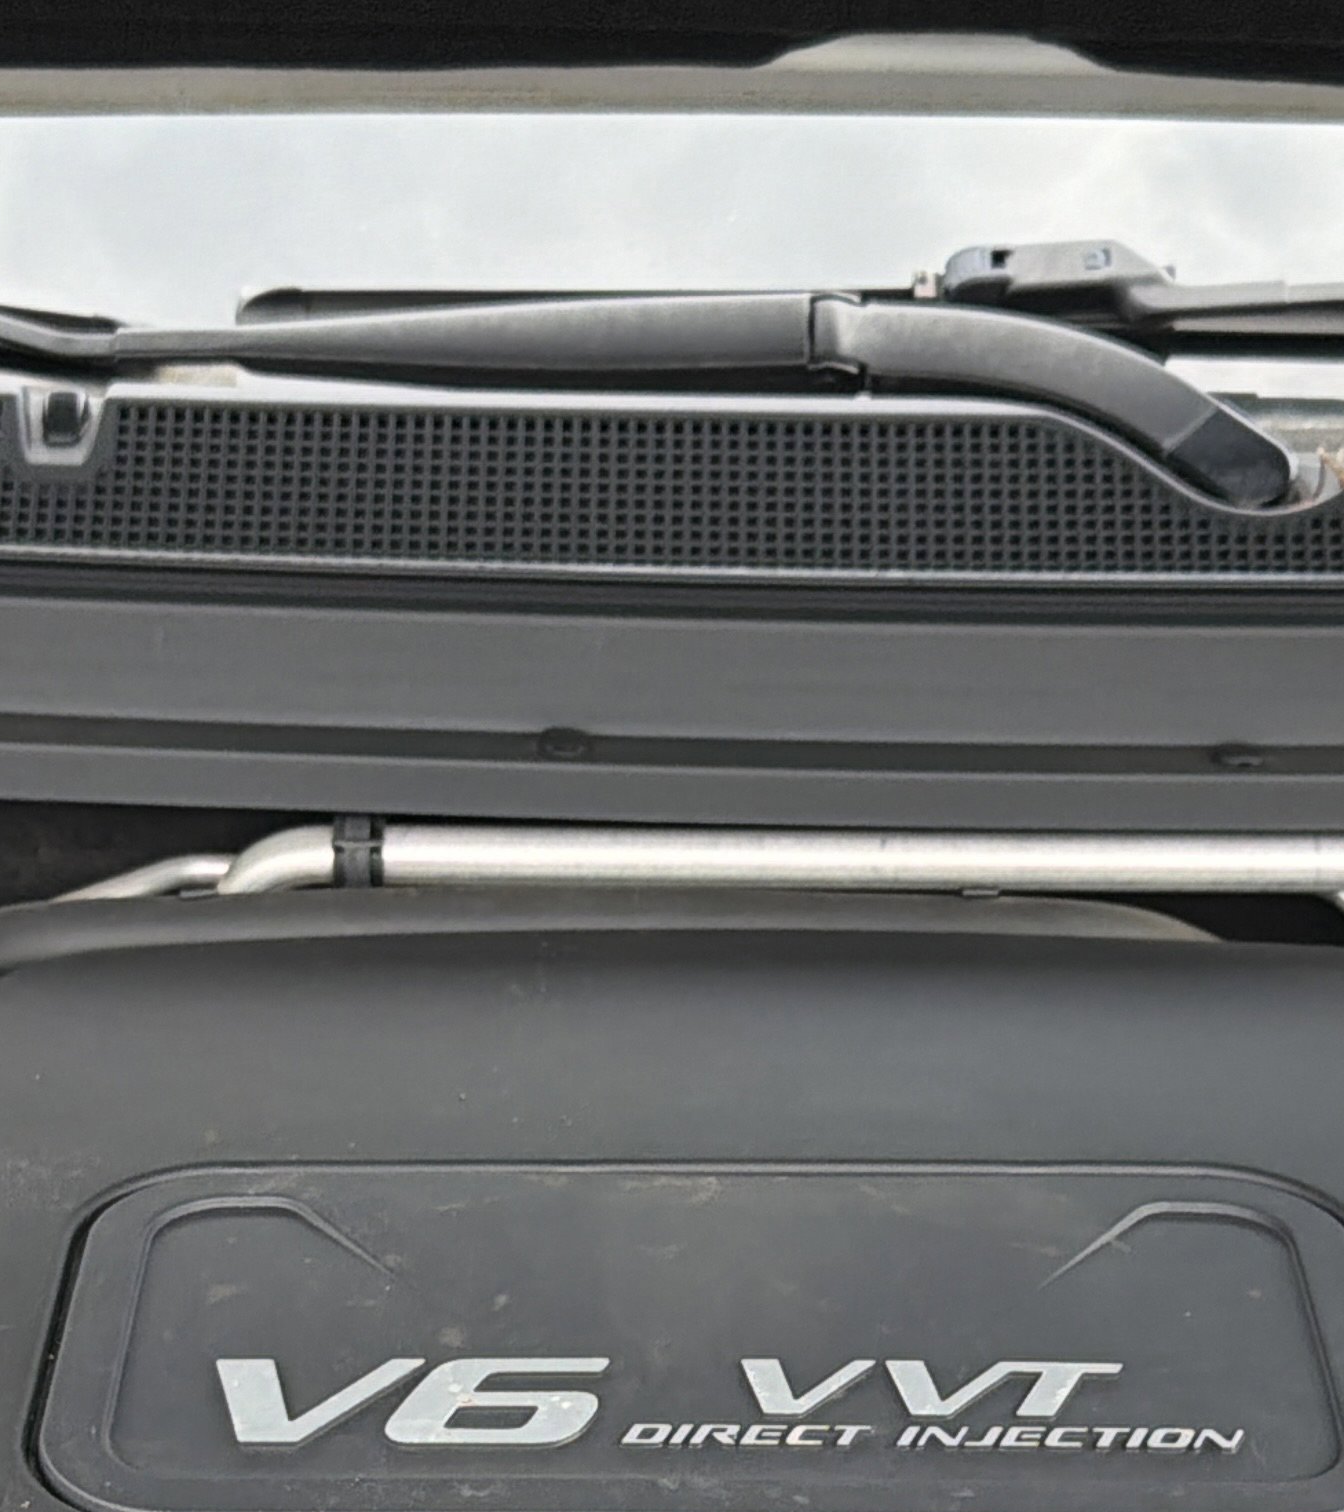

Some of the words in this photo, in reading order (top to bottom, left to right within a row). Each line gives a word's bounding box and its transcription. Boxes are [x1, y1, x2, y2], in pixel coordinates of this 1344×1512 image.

[216, 1357, 611, 1447] V6
[741, 1358, 1124, 1418] VVT
[621, 1423, 872, 1448] DIRECT
[896, 1425, 1244, 1452] INJECTION
